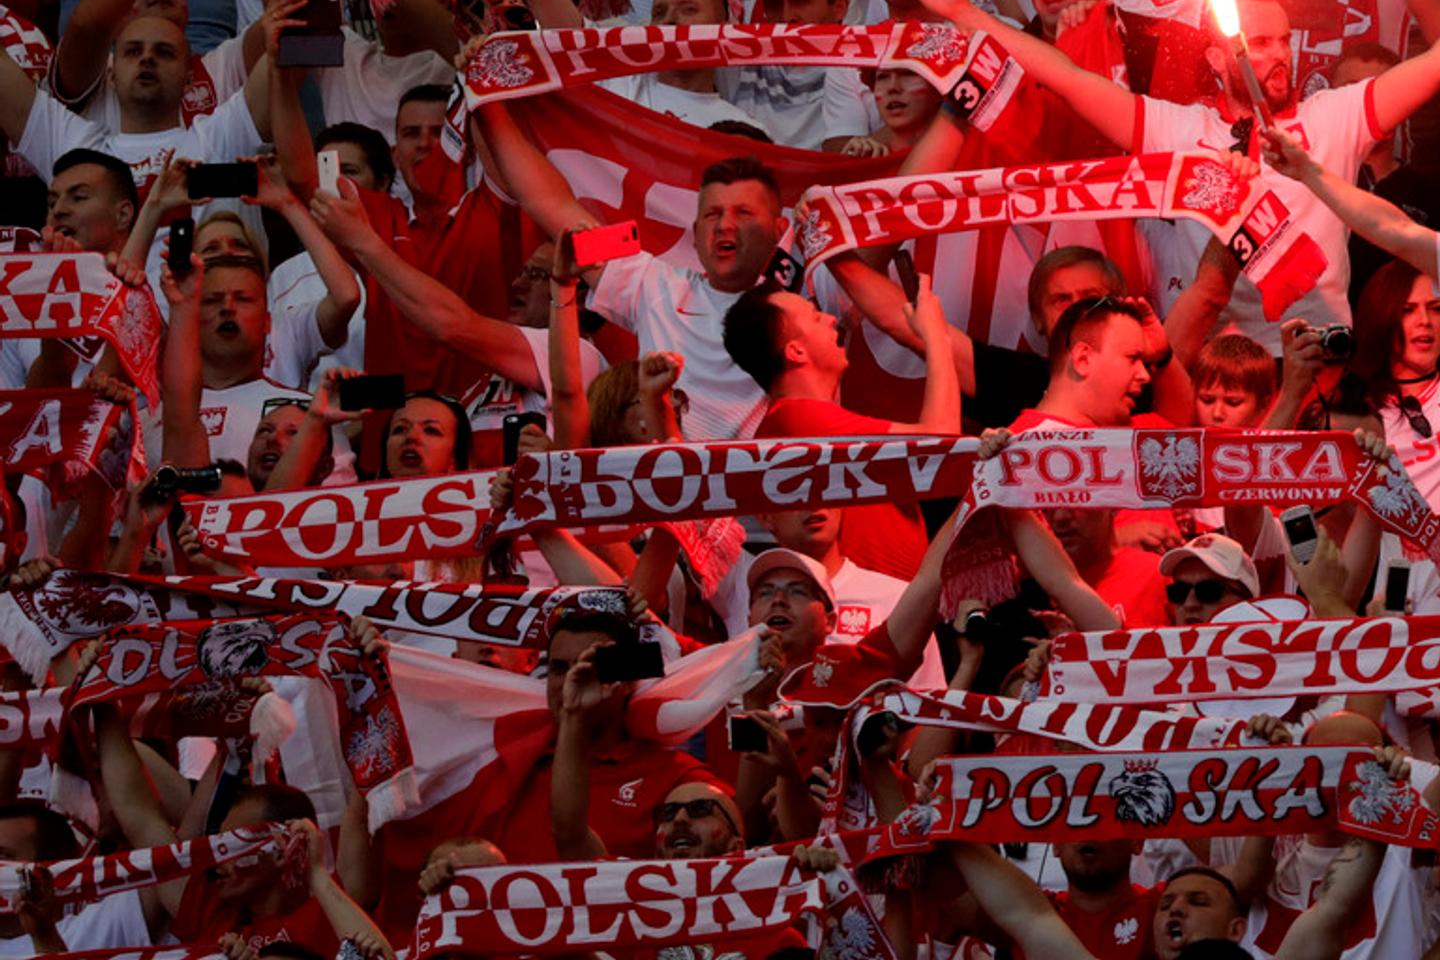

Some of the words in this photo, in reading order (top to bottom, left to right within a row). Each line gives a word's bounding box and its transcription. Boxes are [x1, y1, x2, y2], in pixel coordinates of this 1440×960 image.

[560, 23, 876, 77] POLSKA
[845, 156, 1158, 242] POLSKA
[999, 445, 1125, 487] POL
[1212, 441, 1350, 484] SKA
[1034, 490, 1091, 504] BIAŁO
[1217, 487, 1343, 501] CZERWONYM
[960, 759, 1105, 830] POL
[1180, 755, 1326, 823] SKA
[435, 858, 823, 947] POLSKA
